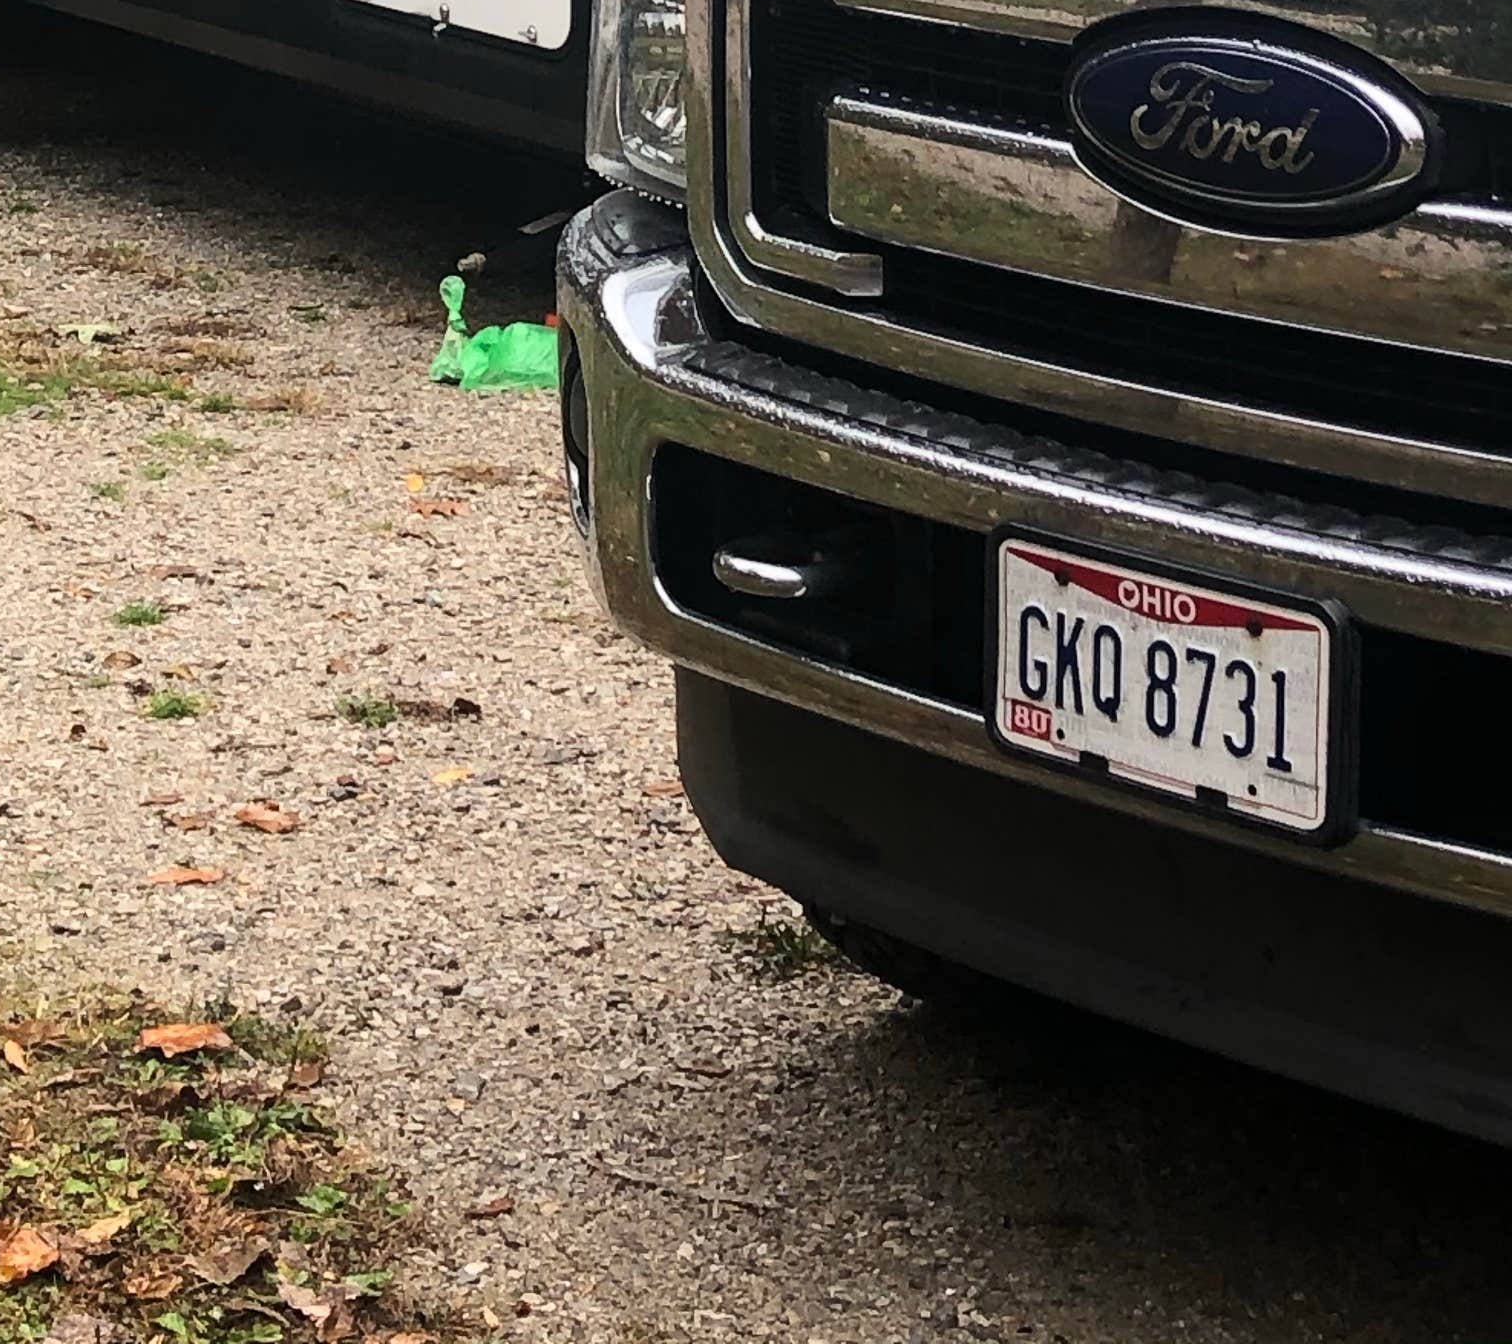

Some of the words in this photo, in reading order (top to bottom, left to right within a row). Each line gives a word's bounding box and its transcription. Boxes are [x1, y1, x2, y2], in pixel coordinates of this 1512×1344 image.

[1130, 61, 1320, 174] Ford
[1118, 580, 1197, 624] OHIO
[1014, 704, 1050, 734] 80
[1019, 605, 1122, 723] GKQ
[1145, 639, 1292, 773] 8731
